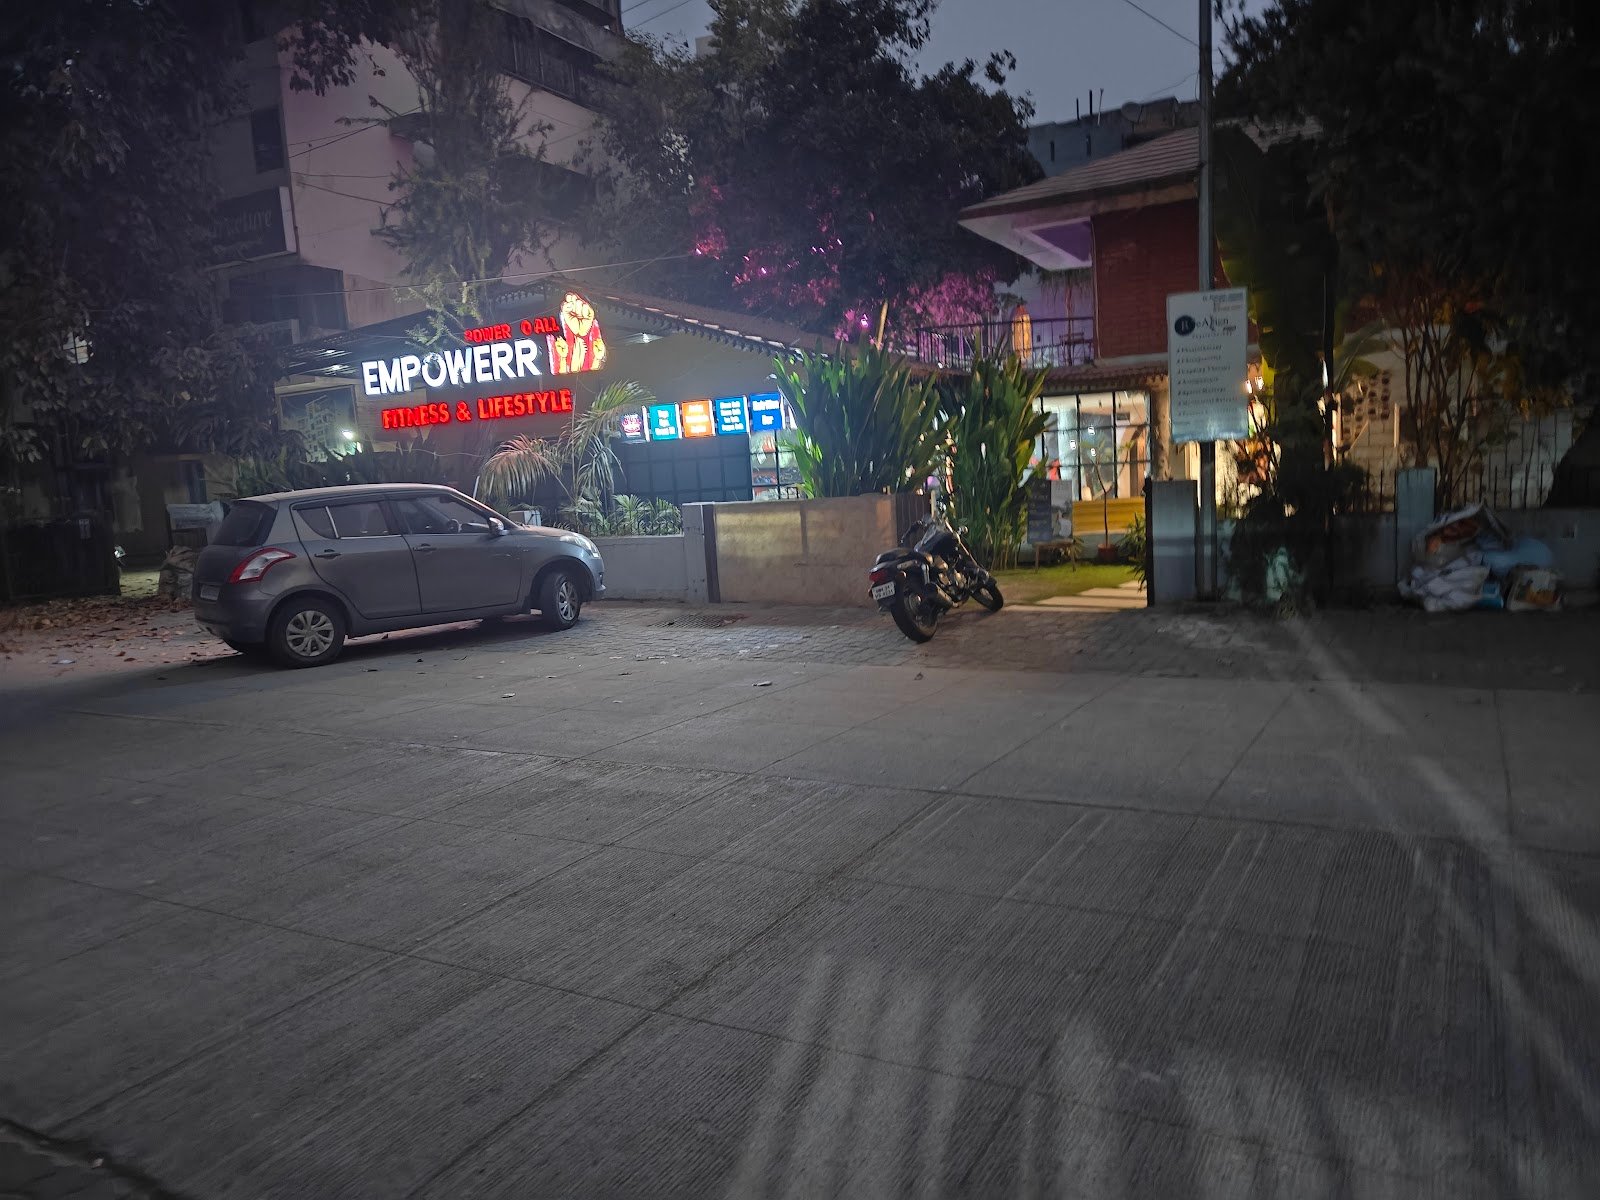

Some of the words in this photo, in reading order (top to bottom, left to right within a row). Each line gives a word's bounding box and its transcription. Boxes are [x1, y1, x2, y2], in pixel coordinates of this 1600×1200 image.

[534, 316, 560, 335] ALL
[362, 340, 542, 395] EMPOWERR
[382, 402, 450, 429] FITNESS
[456, 401, 473, 422] &
[478, 389, 572, 419] LIFESTYLE
